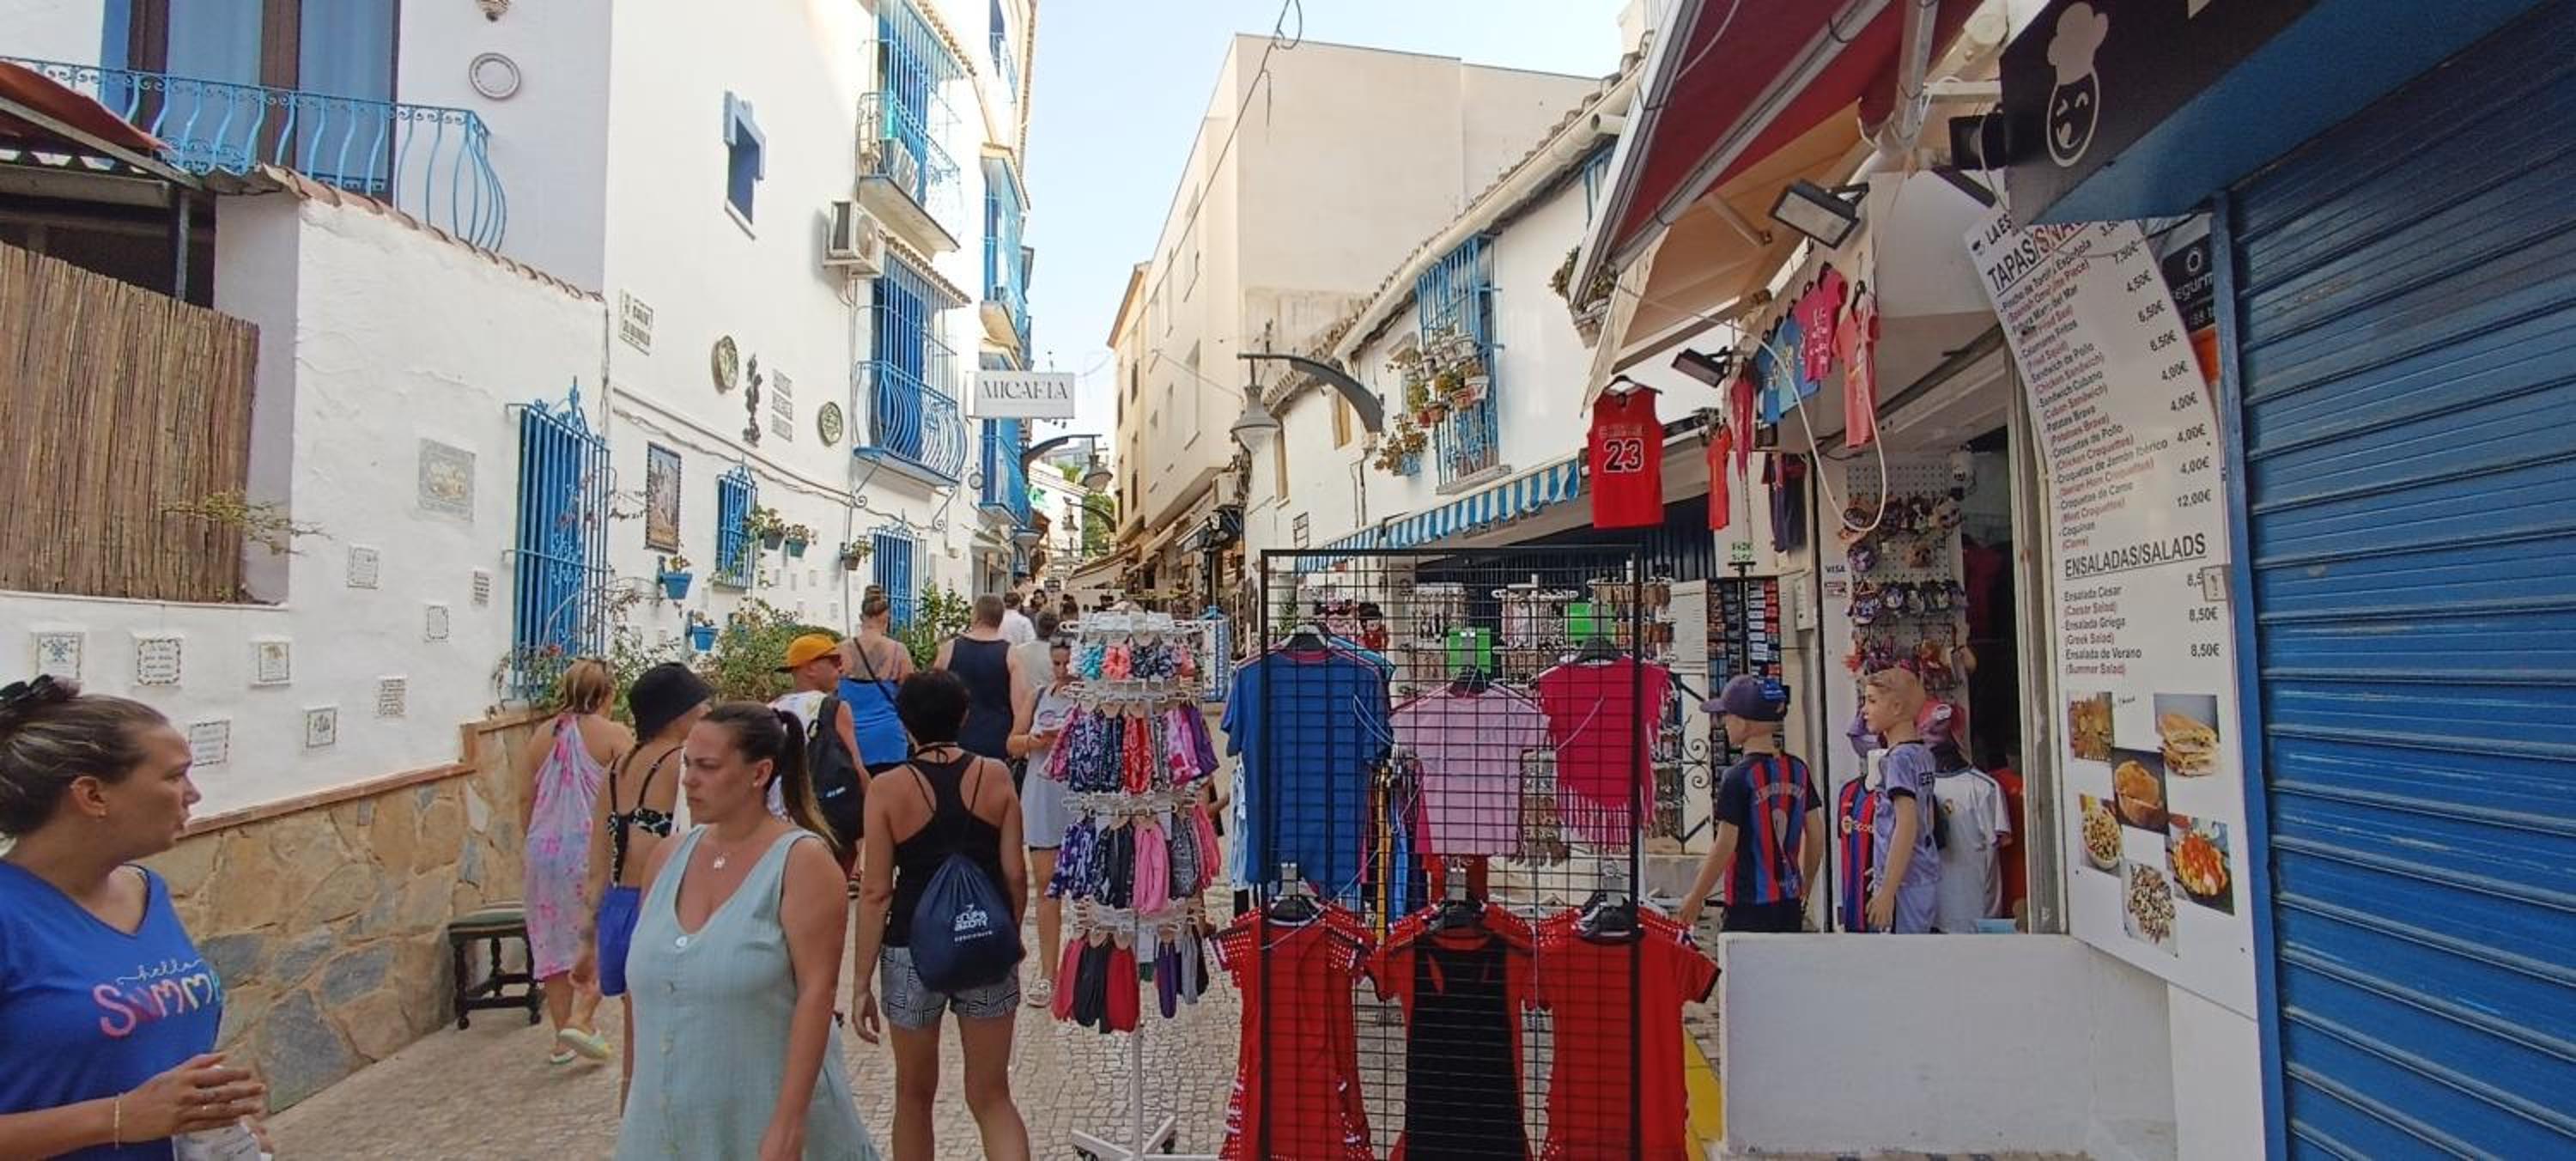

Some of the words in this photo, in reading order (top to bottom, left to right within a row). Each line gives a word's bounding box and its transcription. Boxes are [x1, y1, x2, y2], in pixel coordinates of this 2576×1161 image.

[1987, 222, 2084, 291] TAPAS/SNA
[2161, 360, 2189, 380] 4,00€
[2171, 392, 2198, 412] 4,00€
[2177, 423, 2207, 444] 4,00€
[1603, 438, 1644, 473] 23
[2180, 456, 2209, 475] 4,00€
[2177, 489, 2212, 508] 12,00€
[2065, 532, 2206, 577] ENSALADAS/SALADS
[2064, 588, 2097, 602] Ensalada
[2189, 605, 2218, 623] 8,50€
[2065, 618, 2098, 631] Ensalada
[2065, 647, 2099, 660] Ensalada
[2100, 647, 2111, 660] de
[2190, 643, 2220, 658] 8,50€
